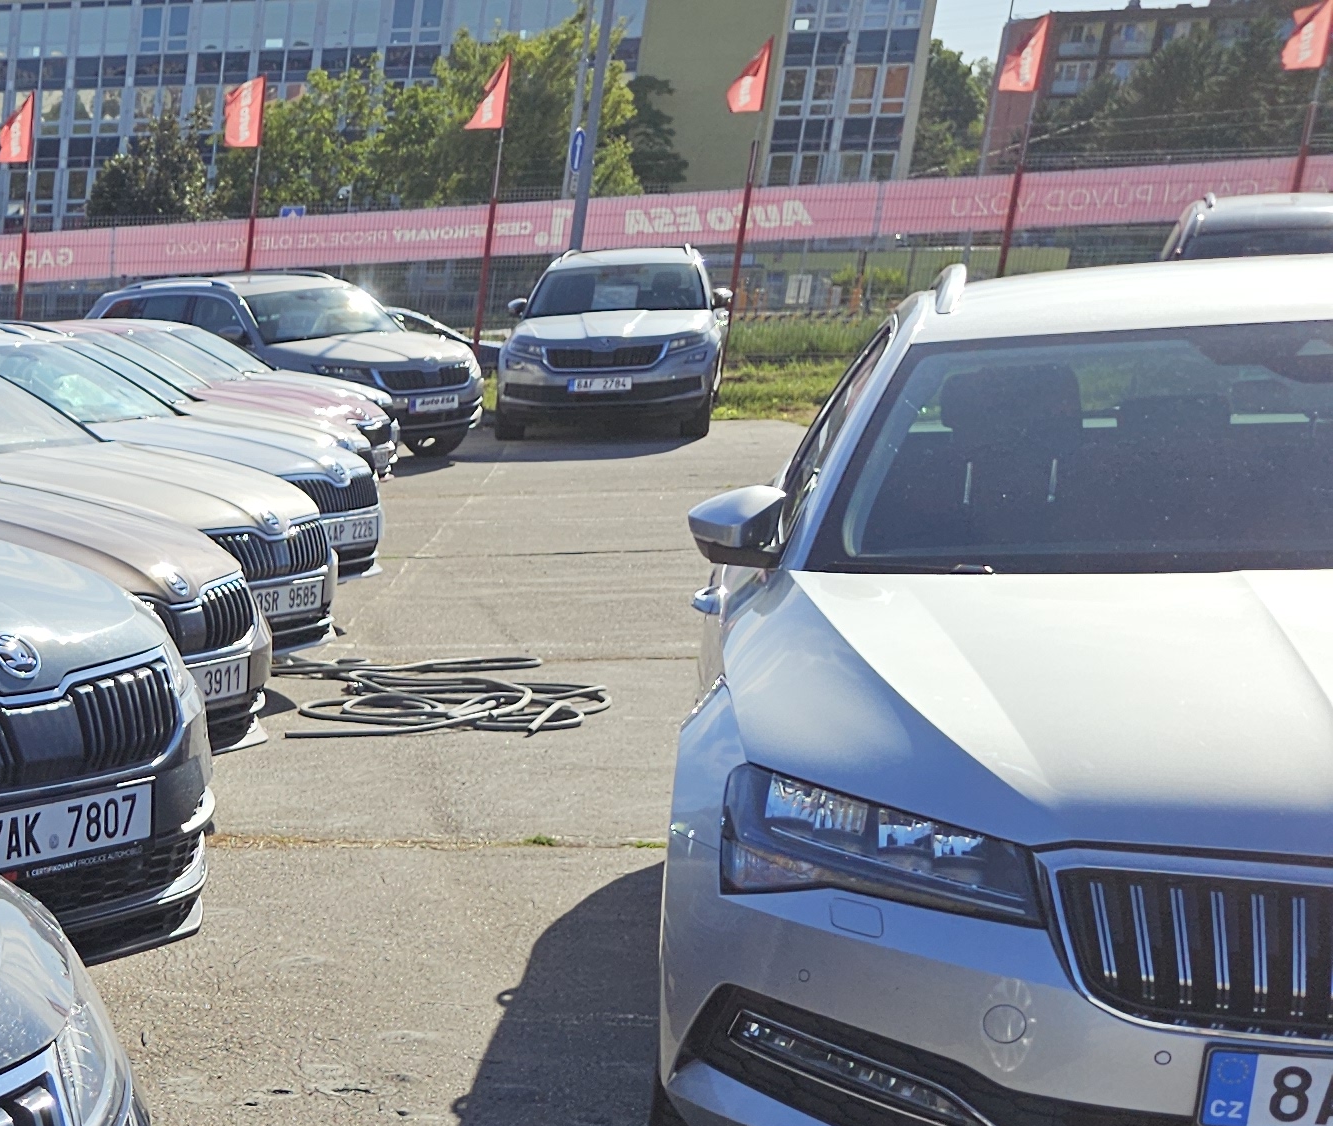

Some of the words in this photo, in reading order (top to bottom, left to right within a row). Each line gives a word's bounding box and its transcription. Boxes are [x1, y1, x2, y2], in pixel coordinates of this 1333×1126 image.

[352, 520, 374, 539] 2226
[288, 584, 318, 609] 9585
[204, 663, 241, 695] 3911
[68, 793, 137, 848] 7807
[32, 859, 77, 877] CERTIFIKOVANÝ
[1210, 1099, 1244, 1119] CZ
